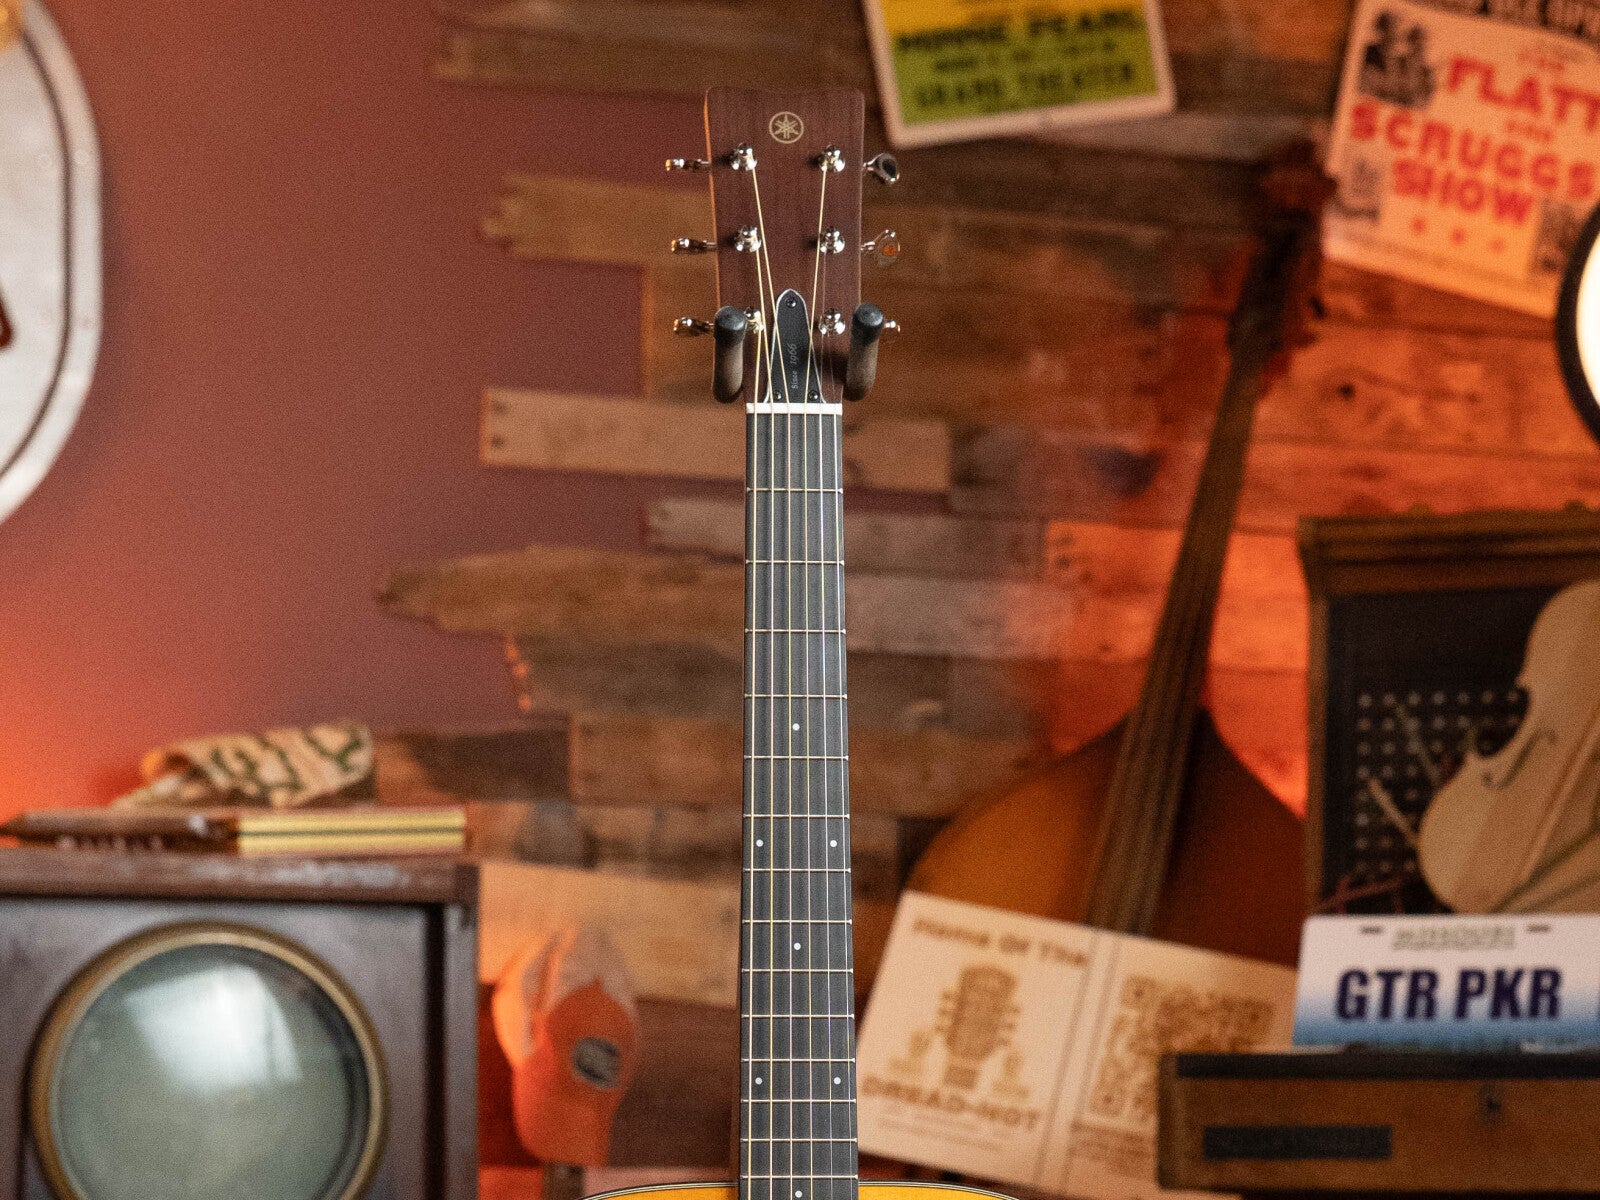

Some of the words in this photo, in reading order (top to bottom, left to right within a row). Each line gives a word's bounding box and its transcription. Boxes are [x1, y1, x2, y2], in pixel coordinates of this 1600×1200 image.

[1447, 54, 1600, 134] FLATT
[1350, 97, 1596, 200] SCRUGGS
[1392, 157, 1536, 228] SHOW
[787, 342, 799, 365] 1966
[1335, 967, 1440, 1021] GTR
[1454, 967, 1562, 1021] PKR
